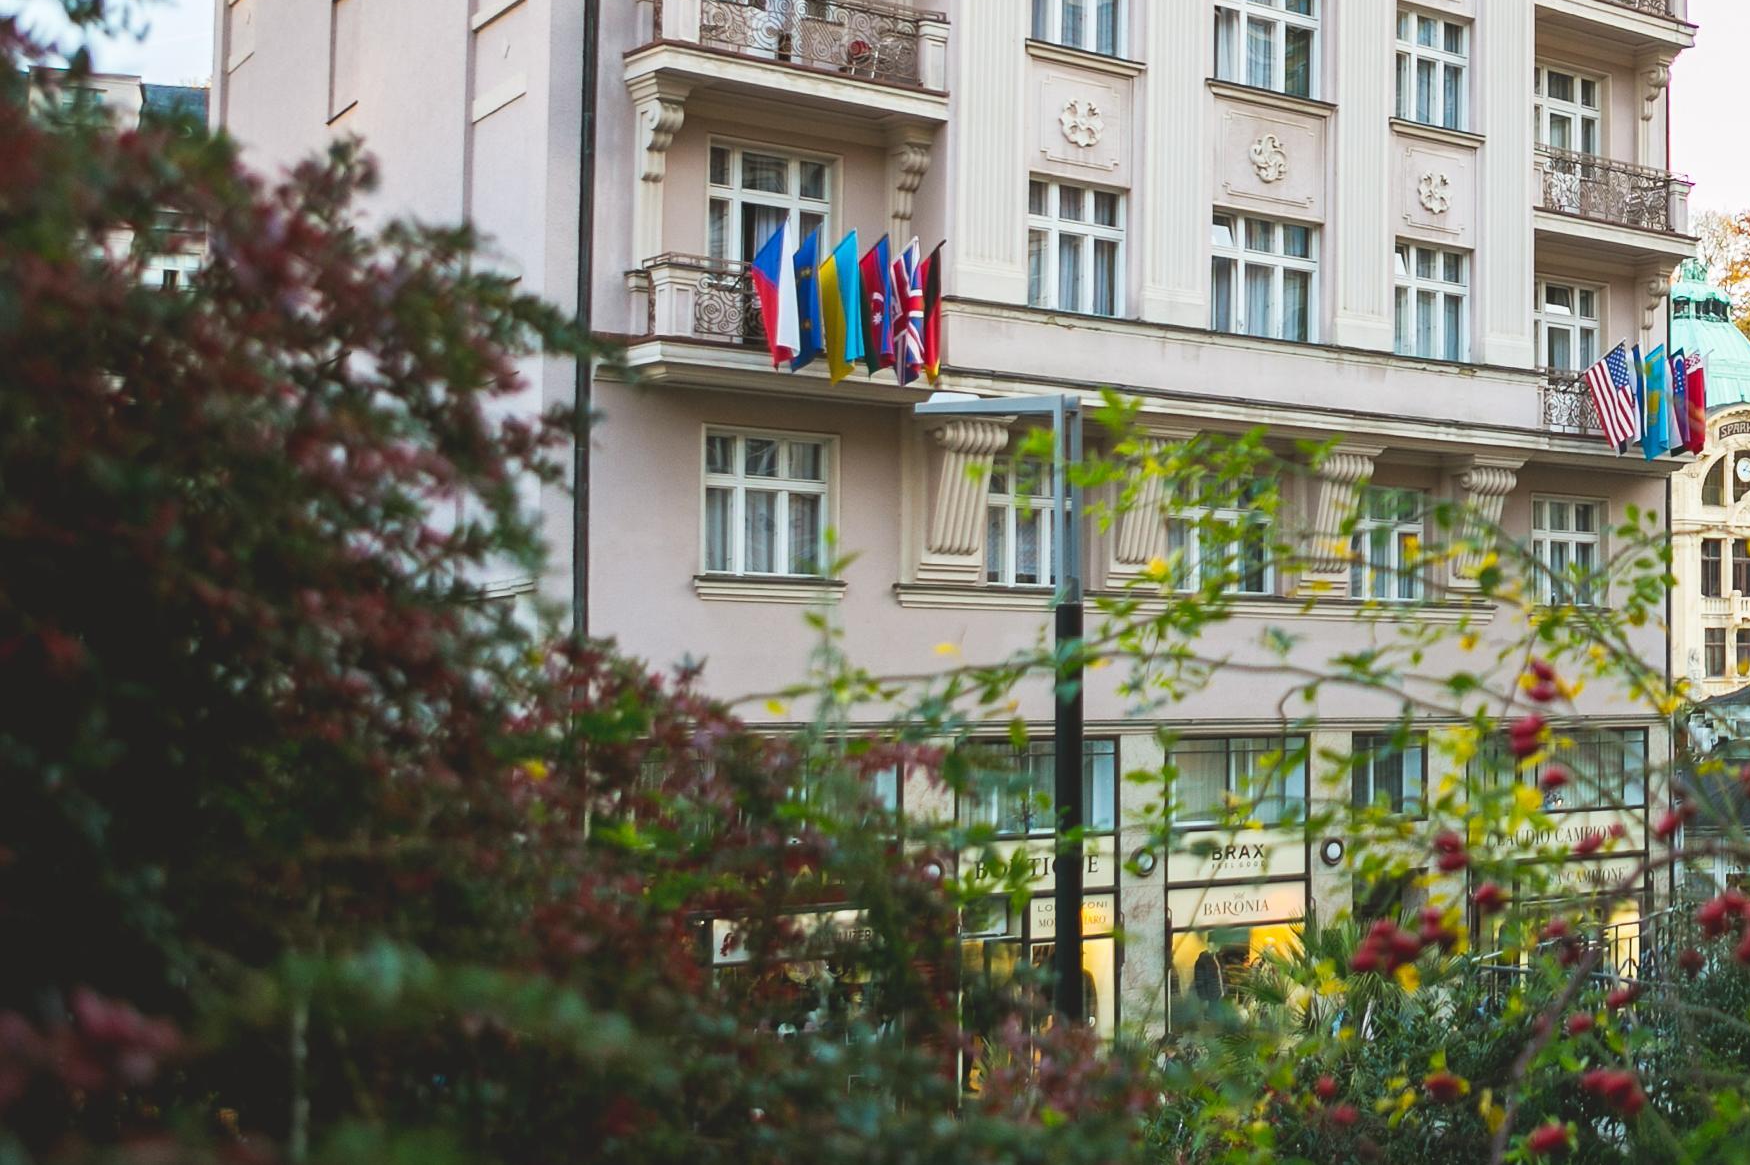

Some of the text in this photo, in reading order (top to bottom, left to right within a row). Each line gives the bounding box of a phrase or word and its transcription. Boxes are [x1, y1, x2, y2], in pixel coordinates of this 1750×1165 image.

[1555, 824, 1622, 843] CAMPION
[1212, 844, 1264, 861] BRAX
[975, 855, 1099, 880] BOTIE
[1203, 899, 1269, 916] BARONIA
